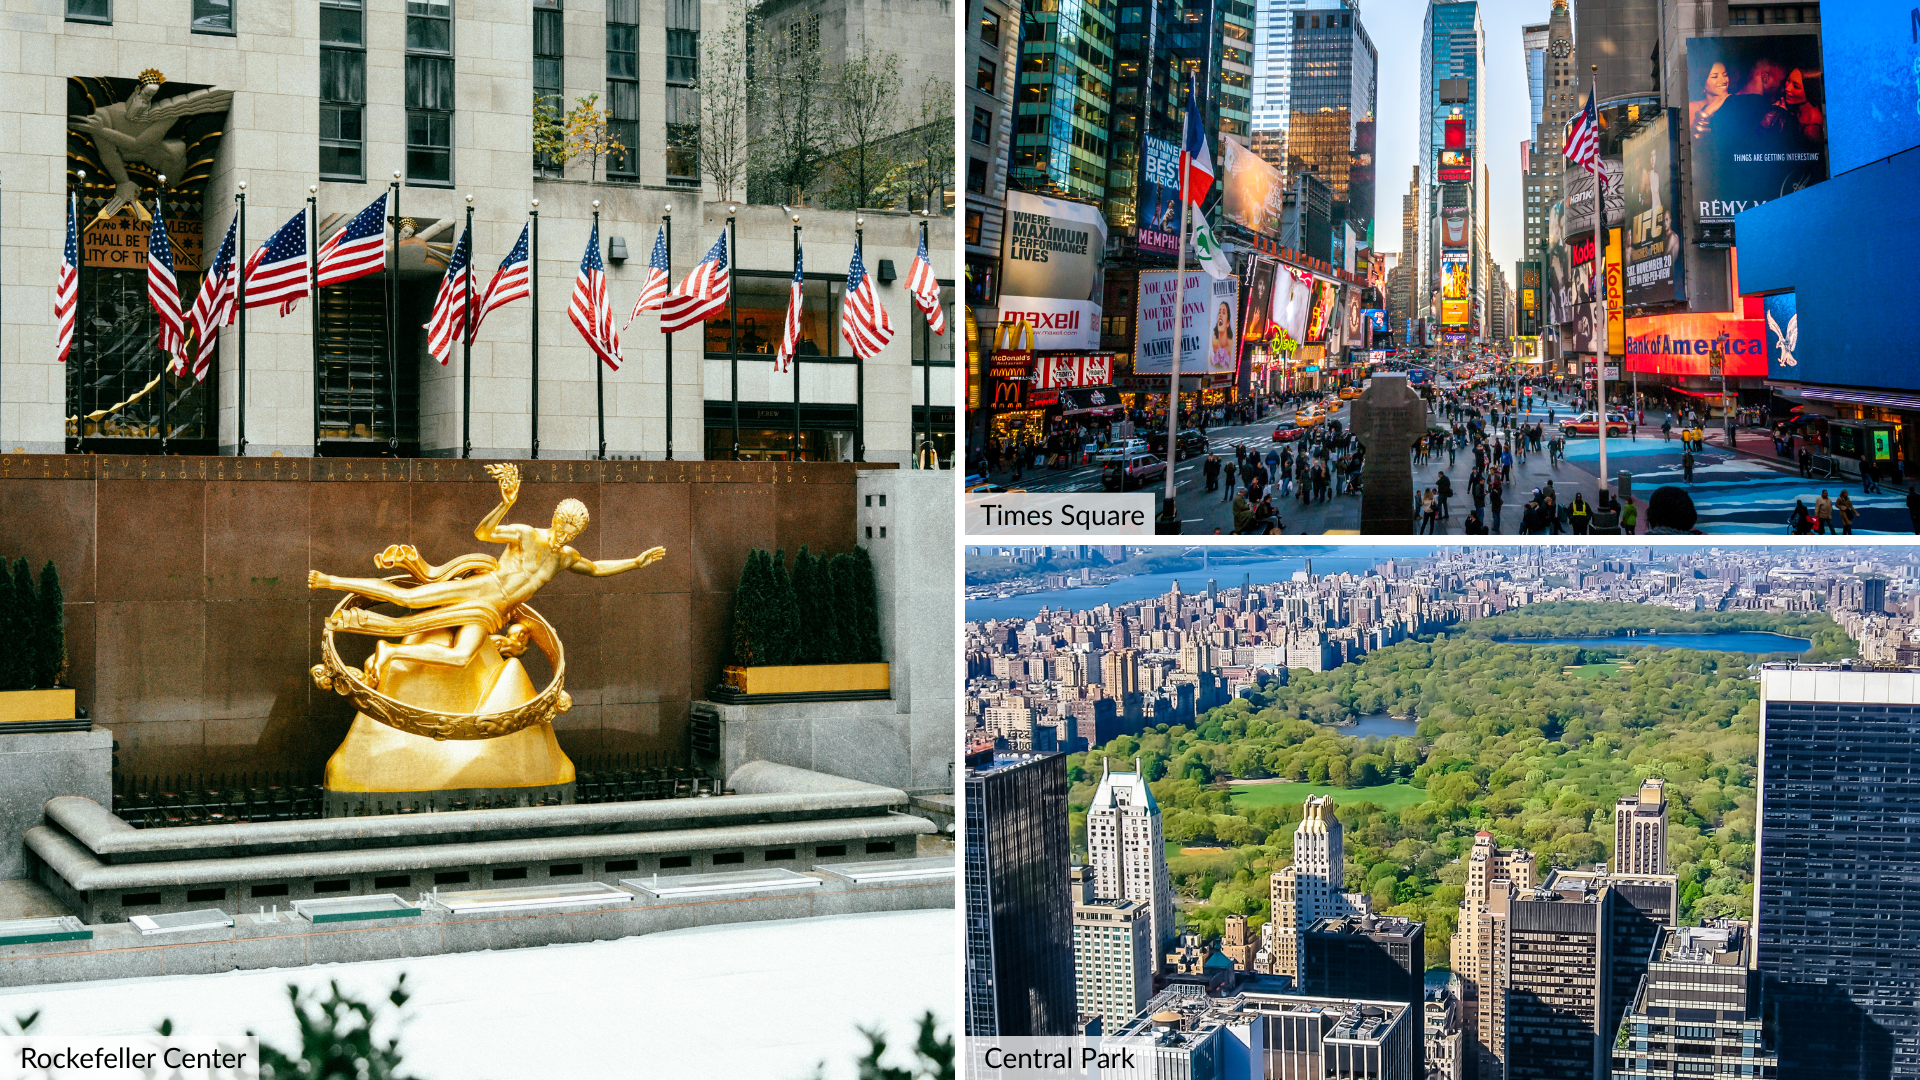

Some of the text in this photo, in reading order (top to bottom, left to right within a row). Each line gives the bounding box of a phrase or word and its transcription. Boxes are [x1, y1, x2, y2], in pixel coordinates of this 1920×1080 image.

[1764, 153, 1785, 161] GETTING
[1699, 198, 1748, 216] RÉMY
[102, 222, 116, 230] AND
[1013, 211, 1051, 226] WHERE
[1632, 204, 1664, 244] UFC
[86, 232, 122, 247] SHALL
[125, 235, 140, 248] BE
[1012, 221, 1089, 245] MAXIMUM
[1010, 246, 1049, 263] LIVES
[1011, 236, 1088, 255] PERFORMANCE
[1573, 236, 1596, 265] Koda
[111, 249, 129, 263] OF
[132, 251, 149, 264] TH
[1636, 256, 1664, 275] NOVEMBER
[1664, 254, 1672, 268] 20
[1144, 275, 1201, 295] YOU ALRADY
[1607, 262, 1622, 322] Kodak
[1160, 290, 1185, 305] KNO
[1143, 301, 1205, 320] YOU'RE ONNA
[1004, 310, 1080, 330] maxell
[1157, 318, 1176, 332] LOV
[1143, 340, 1174, 358] MAMM
[1626, 333, 1763, 355] Bank of America
[180, 459, 297, 469] TEACHER
[382, 462, 457, 471] EVERY
[680, 464, 716, 472] THE
[43, 470, 109, 478] HATH
[141, 470, 243, 480] PROVED
[273, 472, 299, 480] TO
[327, 472, 439, 481] MORTALS
[519, 474, 574, 482] EANS
[601, 474, 623, 482] TO
[647, 474, 732, 482] MIGHTY
[757, 475, 807, 483] ENDS
